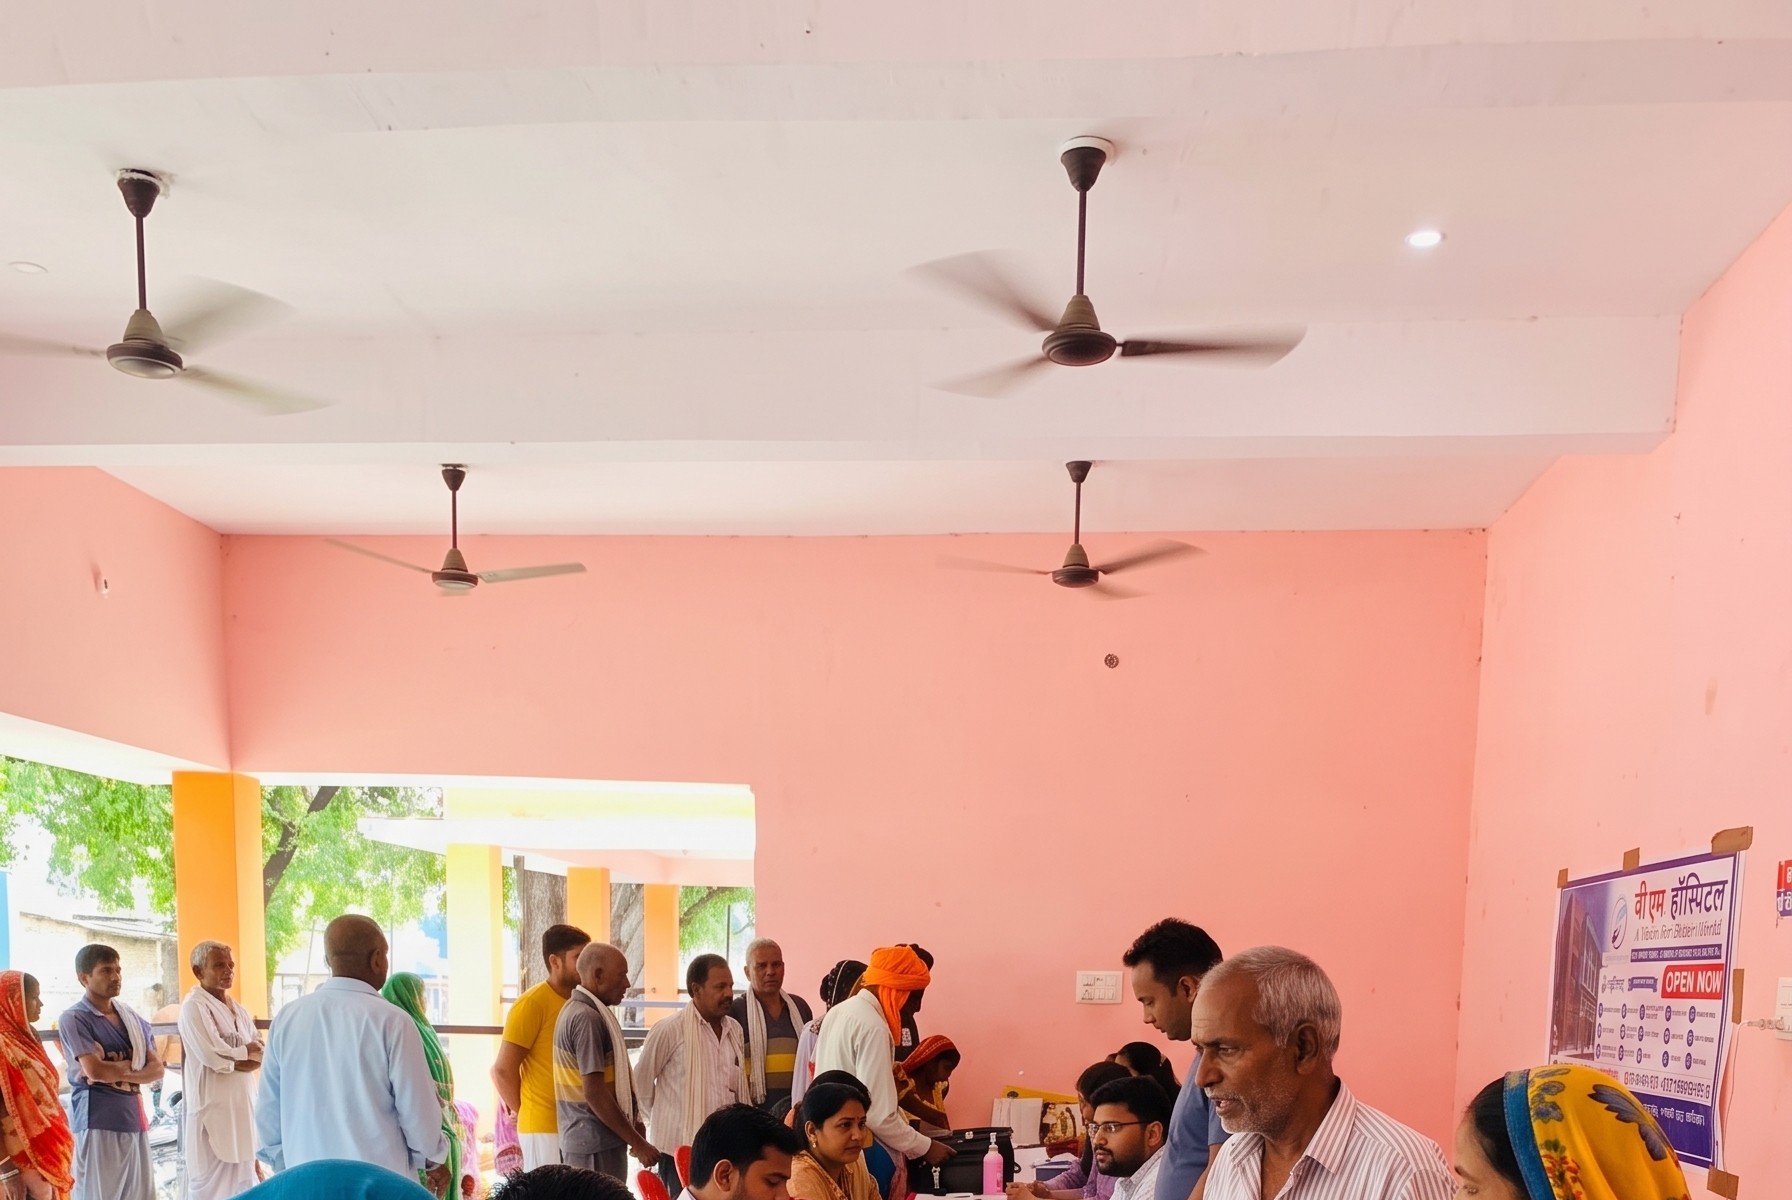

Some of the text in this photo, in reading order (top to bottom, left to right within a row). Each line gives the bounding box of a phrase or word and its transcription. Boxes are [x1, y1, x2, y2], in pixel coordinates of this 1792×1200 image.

[1671, 872, 1729, 921] हॉस्पिटल
[1665, 970, 1723, 994] OPEN NOW
